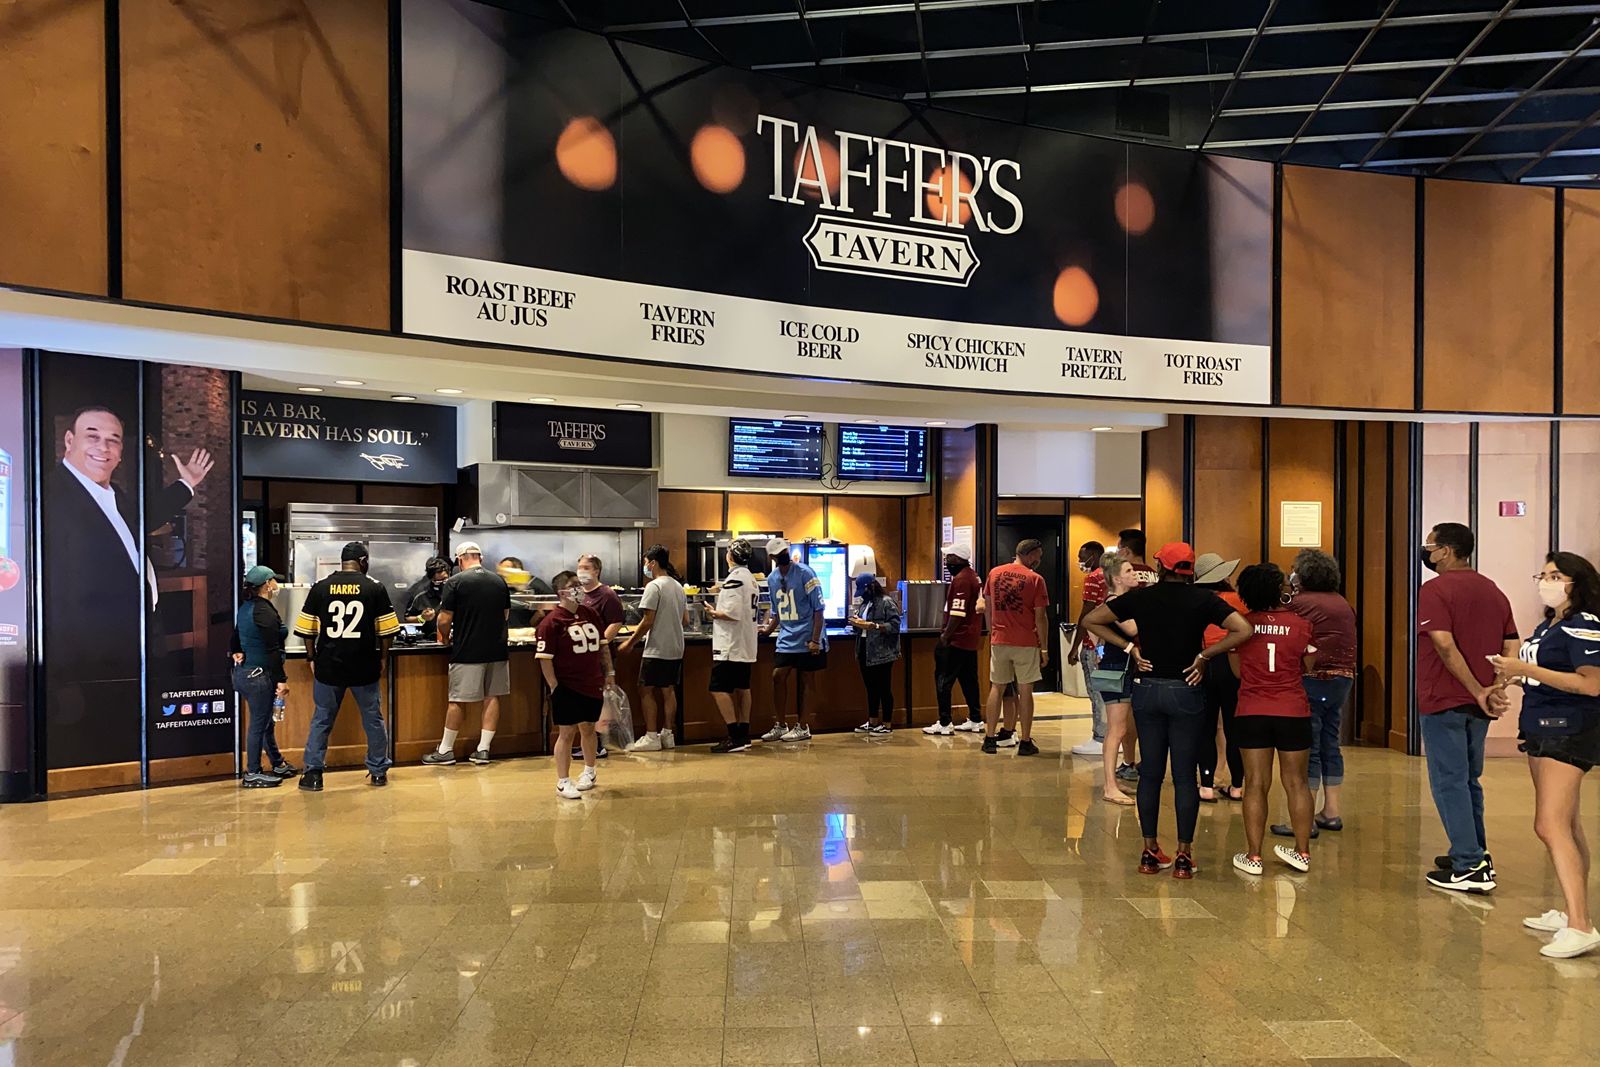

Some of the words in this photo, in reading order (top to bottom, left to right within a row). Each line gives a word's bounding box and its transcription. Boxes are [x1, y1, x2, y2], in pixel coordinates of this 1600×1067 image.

[757, 114, 1024, 235] TAFFER'S
[825, 230, 962, 273] TAVERN
[446, 275, 519, 301] ROAST
[522, 286, 576, 310] BEEF
[477, 302, 507, 322] AU
[510, 306, 548, 328] JUS
[639, 302, 716, 328] TAVERN
[651, 324, 705, 346] FRIES
[780, 320, 809, 338] ICE
[811, 324, 860, 344] COLD
[797, 341, 842, 360] BEER
[907, 333, 951, 352] SPICY
[955, 338, 1026, 358] CHICKEN
[1065, 347, 1123, 365] TAVERN
[925, 353, 1008, 373] SANDWICH
[1061, 363, 1127, 382] PRETZEL
[1164, 353, 1194, 369] TOT
[1196, 355, 1242, 372] ROAST
[1184, 371, 1223, 386] FRIES
[241, 400, 257, 415] IS
[264, 402, 277, 417] A
[283, 403, 327, 422] BAR,
[241, 420, 320, 440] TAVERN
[325, 426, 363, 443] HAS
[548, 421, 606, 440] TAFFER'S
[330, 584, 361, 595] HARRIS
[776, 589, 799, 621] 21
[952, 599, 966, 610] 21
[327, 600, 364, 639] 32
[1254, 625, 1291, 636] MURRAY
[568, 623, 600, 654] 99
[1267, 643, 1276, 672] 1
[162, 689, 225, 699] @TAFFERTAVERN
[156, 717, 231, 729] TAFFERTAVERN.COM
